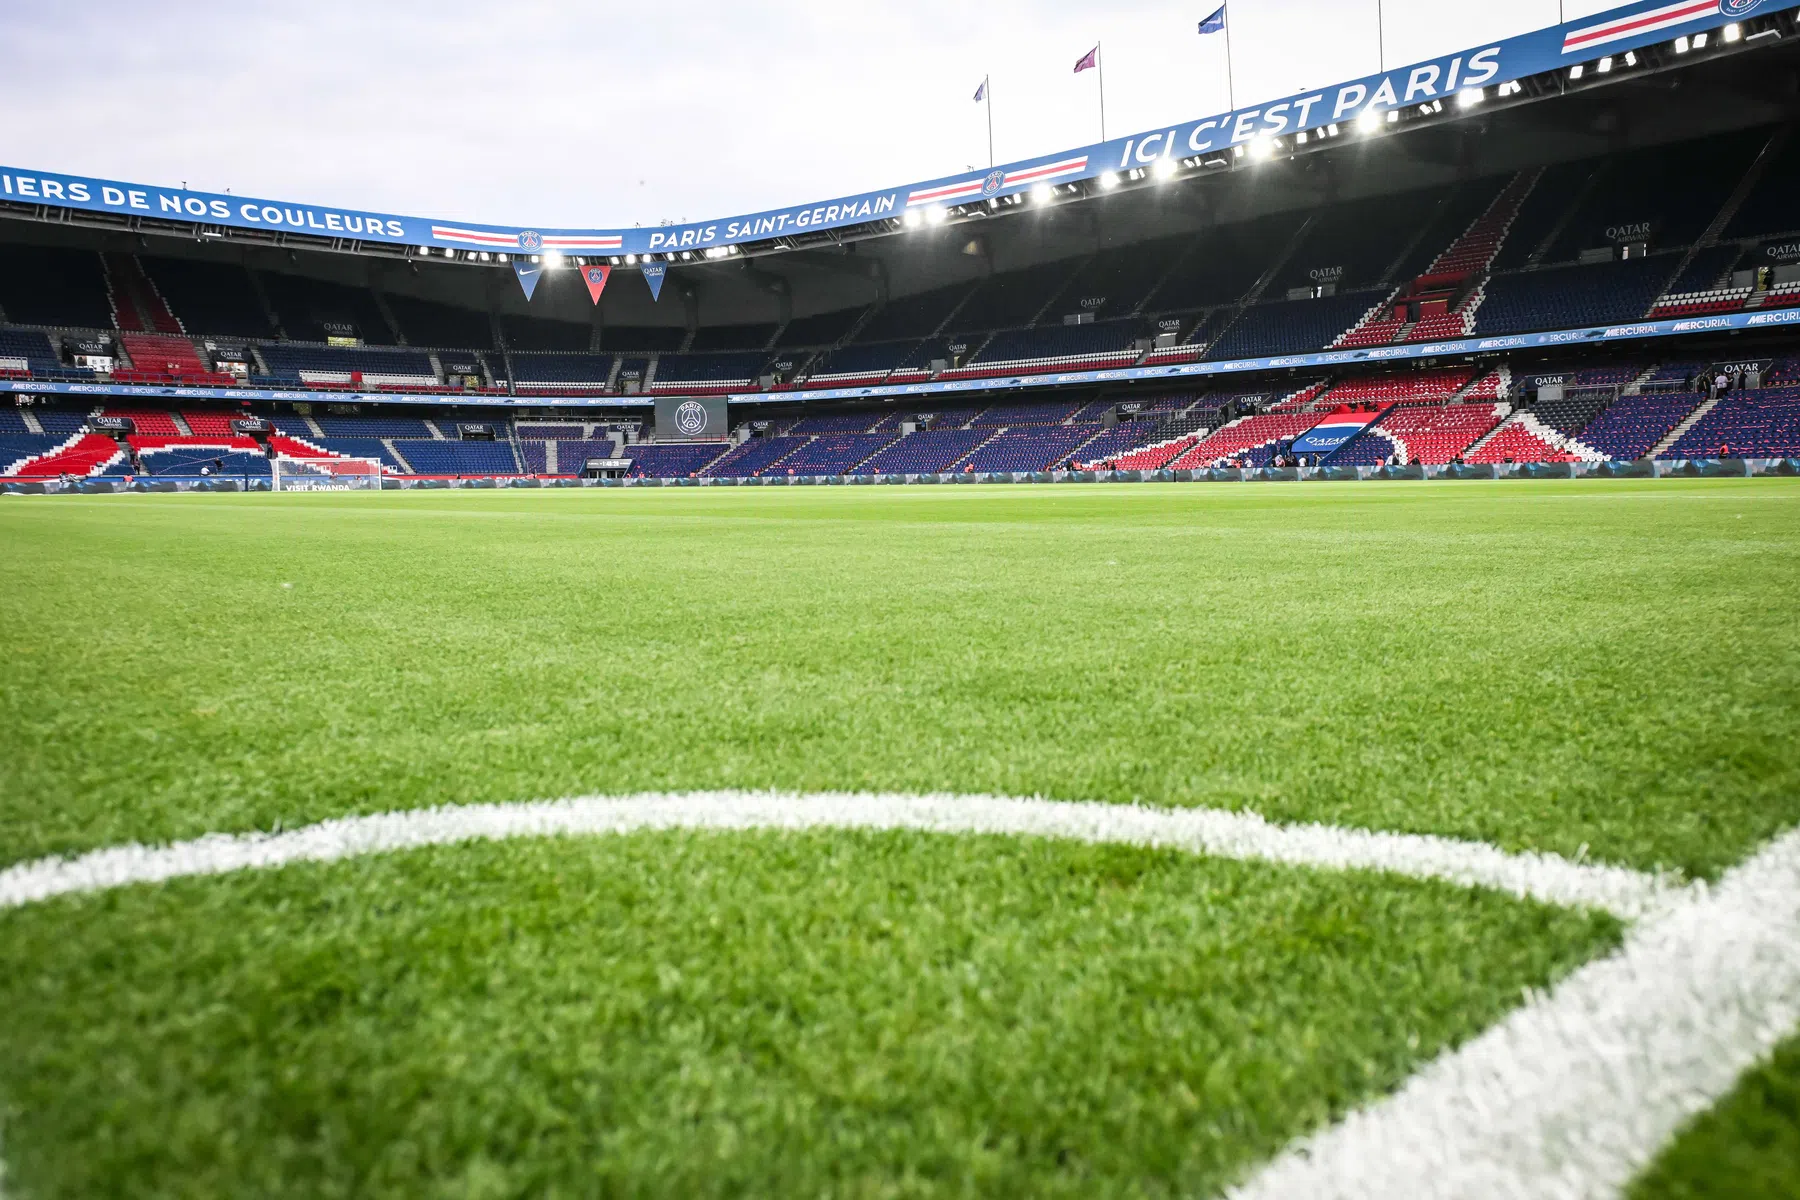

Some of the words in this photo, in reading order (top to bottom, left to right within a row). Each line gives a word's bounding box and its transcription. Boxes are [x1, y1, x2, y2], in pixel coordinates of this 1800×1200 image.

[1119, 130, 1176, 168] ICI
[1332, 47, 1501, 119] PARIS
[2, 174, 91, 202] IERS
[102, 186, 150, 210] DE
[159, 194, 231, 218] NOS
[240, 203, 405, 237] COULEURS
[649, 226, 716, 249] PARIS
[725, 193, 896, 239] SAINT-GERMAIN
[1605, 222, 1650, 239] QATAR
[1309, 266, 1343, 280] QATAR
[324, 322, 353, 331] QATAR
[1158, 319, 1180, 328] QATAR
[1180, 365, 1214, 373] MERCURIAL
[1223, 360, 1260, 370] MERCURIAL
[1269, 357, 1307, 366] MERCURIAL
[1368, 347, 1410, 358] MERCURIAL
[1422, 342, 1467, 354] MERCURIAL
[1478, 337, 1527, 349] MERCURIAL
[1603, 325, 1658, 338] MERCURIAL
[1672, 318, 1732, 331] MERCURIAL
[1747, 311, 1800, 325] MERCURI
[775, 361, 793, 369] QATAR
[1724, 362, 1759, 374] QATAR
[1535, 375, 1563, 387] QATAR
[11, 383, 57, 391] MERCURIAL
[68, 385, 112, 393] MERCURIAL
[1241, 395, 1262, 403] QATAR
[1121, 403, 1141, 411] QATAR
